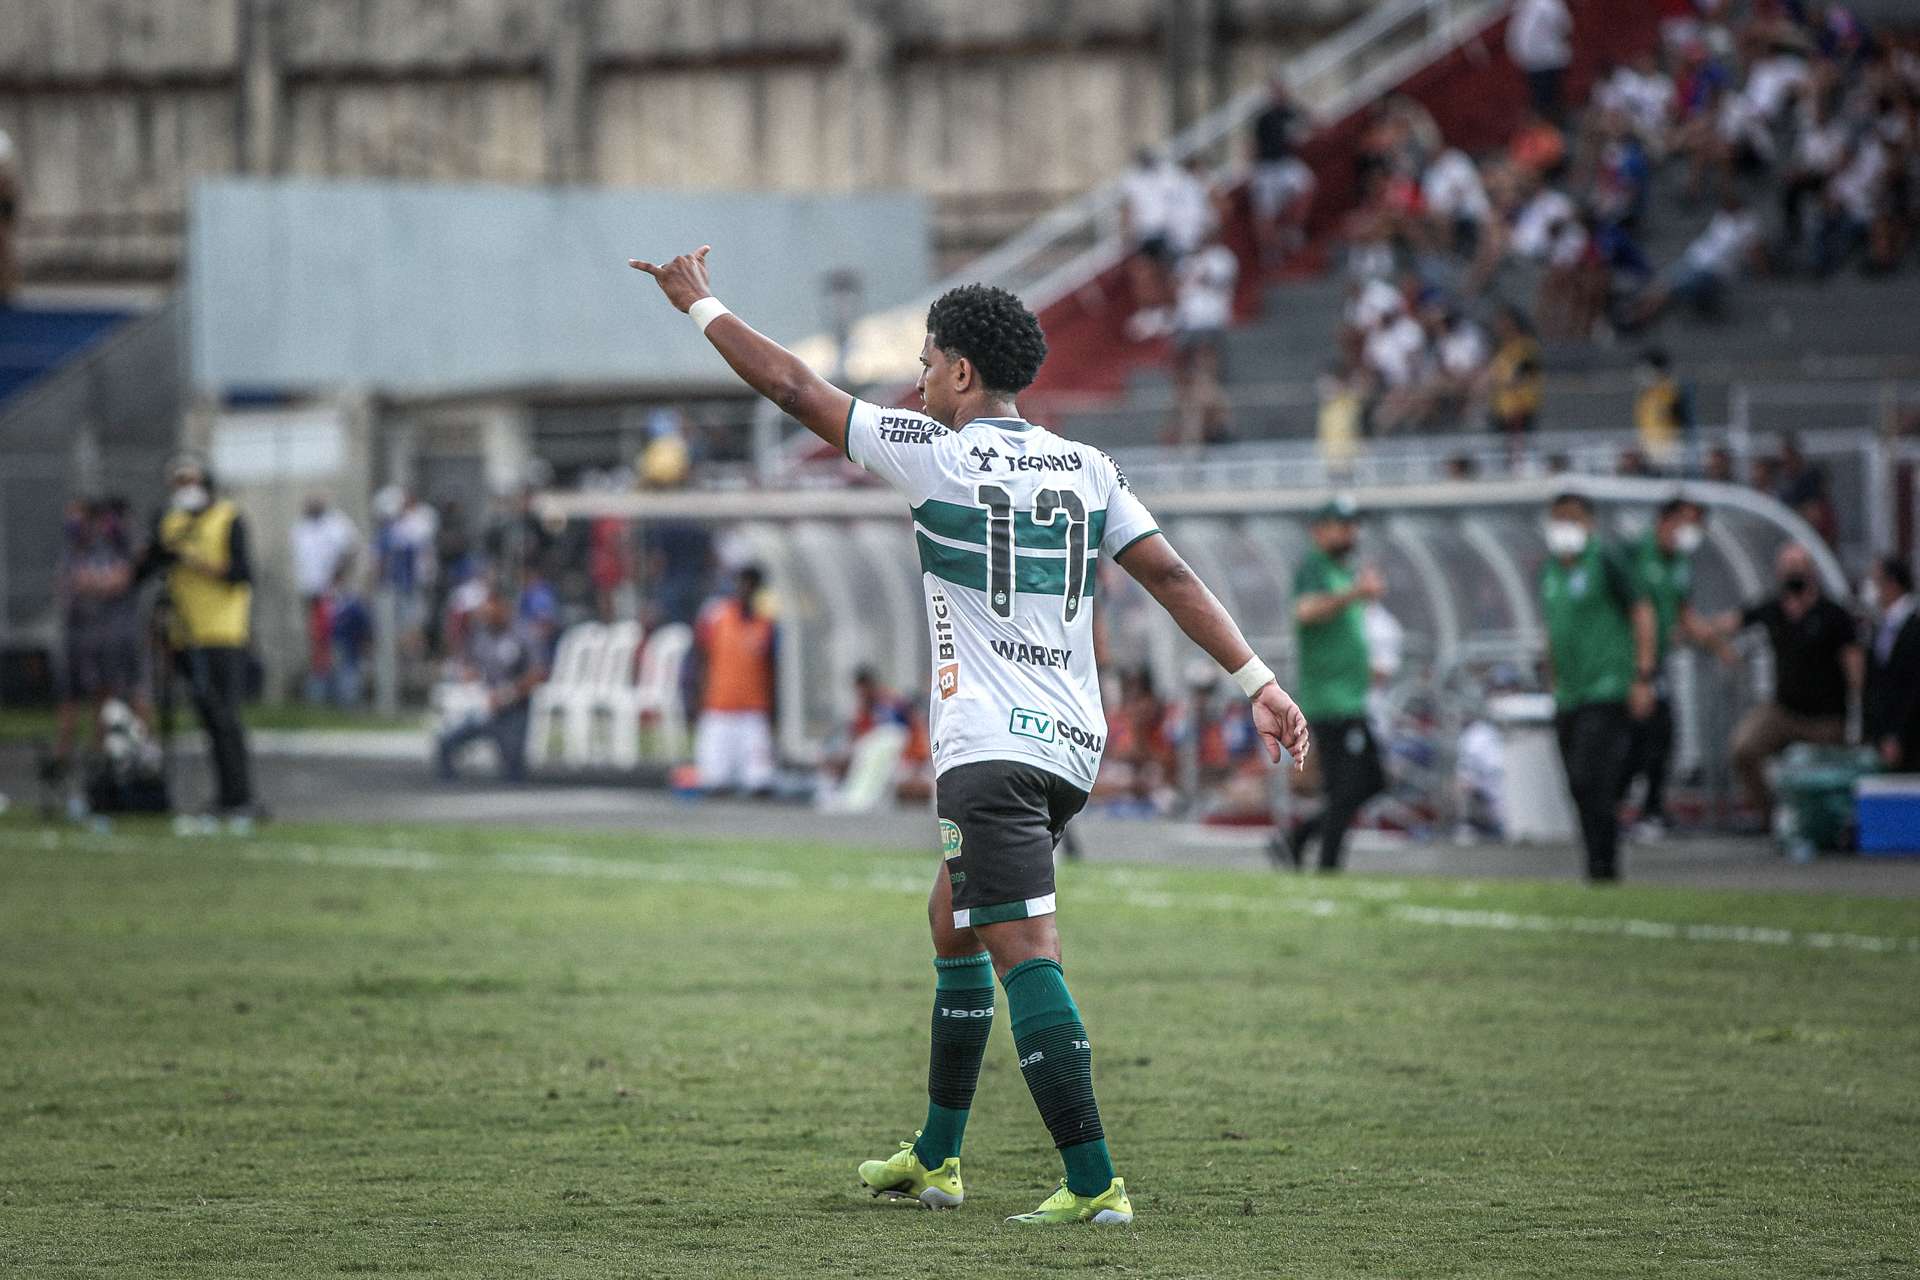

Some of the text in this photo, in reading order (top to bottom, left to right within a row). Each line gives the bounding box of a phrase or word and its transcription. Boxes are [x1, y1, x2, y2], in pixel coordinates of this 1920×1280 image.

[881, 416, 922, 430] PRO
[879, 427, 932, 444] TORK
[1005, 452, 1082, 472] TEQUALY
[977, 483, 1087, 623] 17
[990, 640, 1072, 670] WARLEY
[1017, 714, 1050, 734] TV
[941, 1007, 994, 1018] 1909
